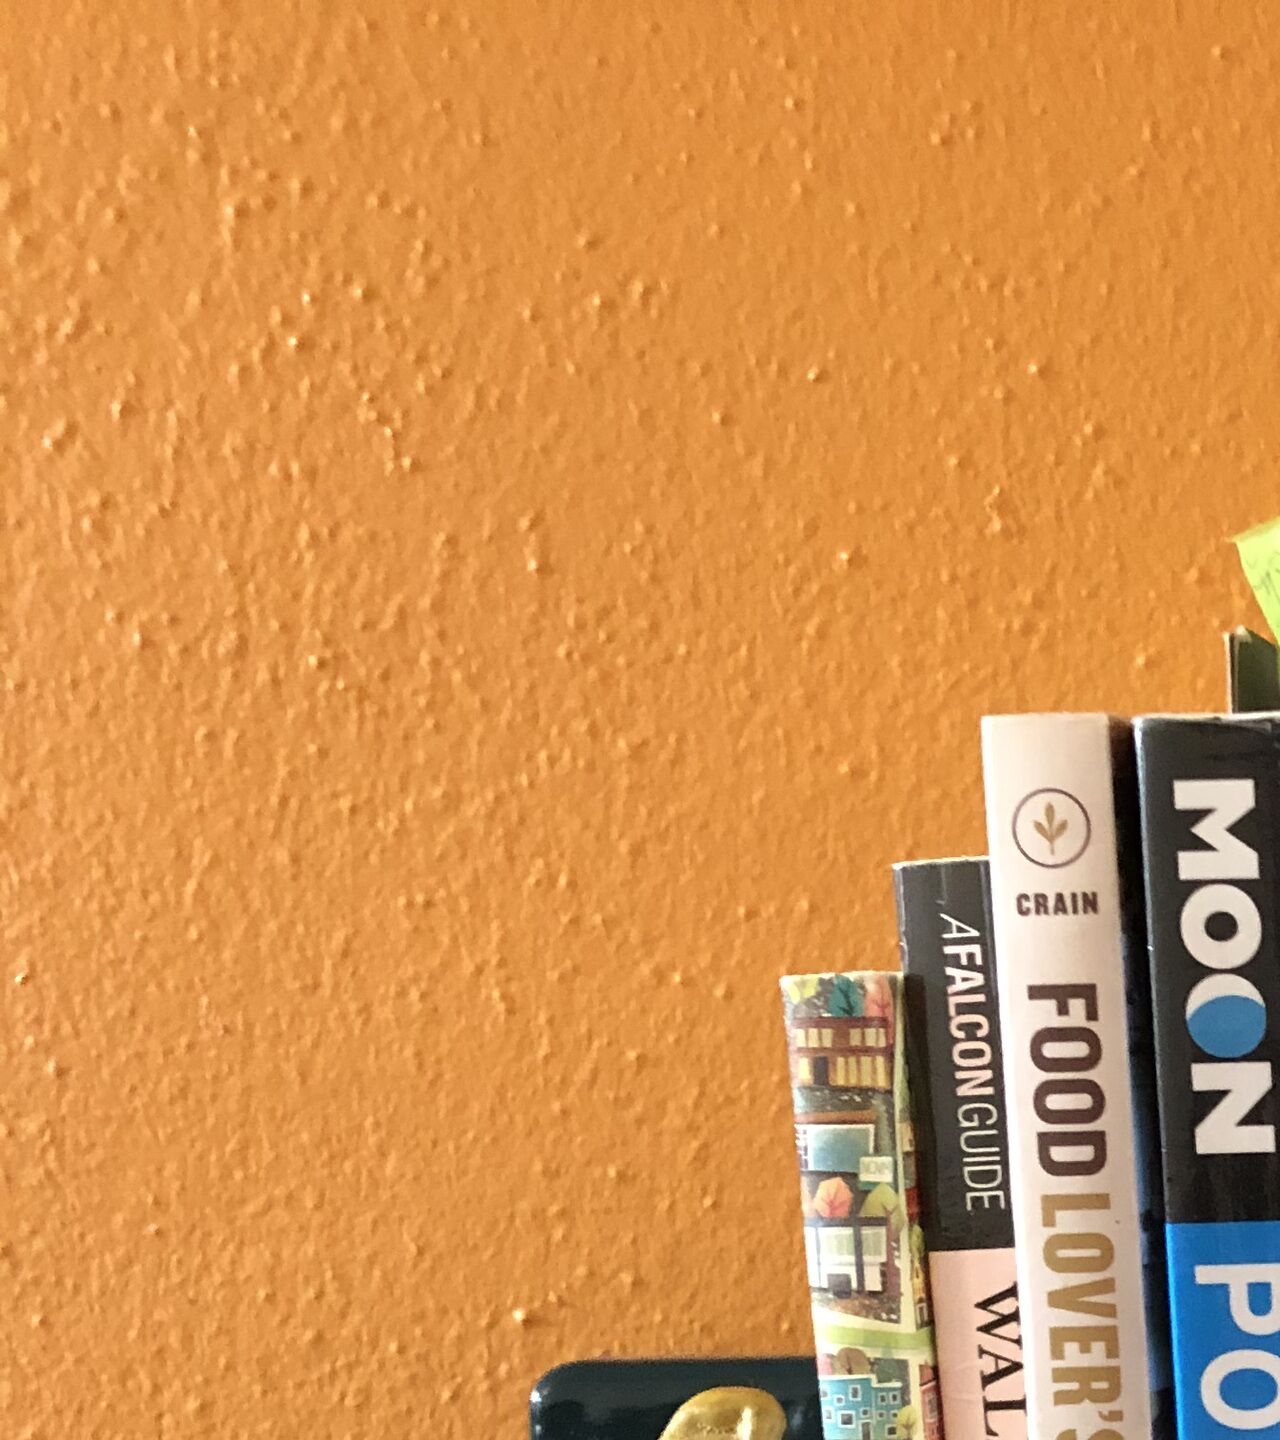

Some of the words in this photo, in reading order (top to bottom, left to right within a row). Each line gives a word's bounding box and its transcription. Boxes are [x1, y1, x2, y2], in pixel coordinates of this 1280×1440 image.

[1016, 891, 1099, 916] CRAIN
[1173, 778, 1276, 1155] MOON
[1027, 983, 1108, 1177] FOOD
